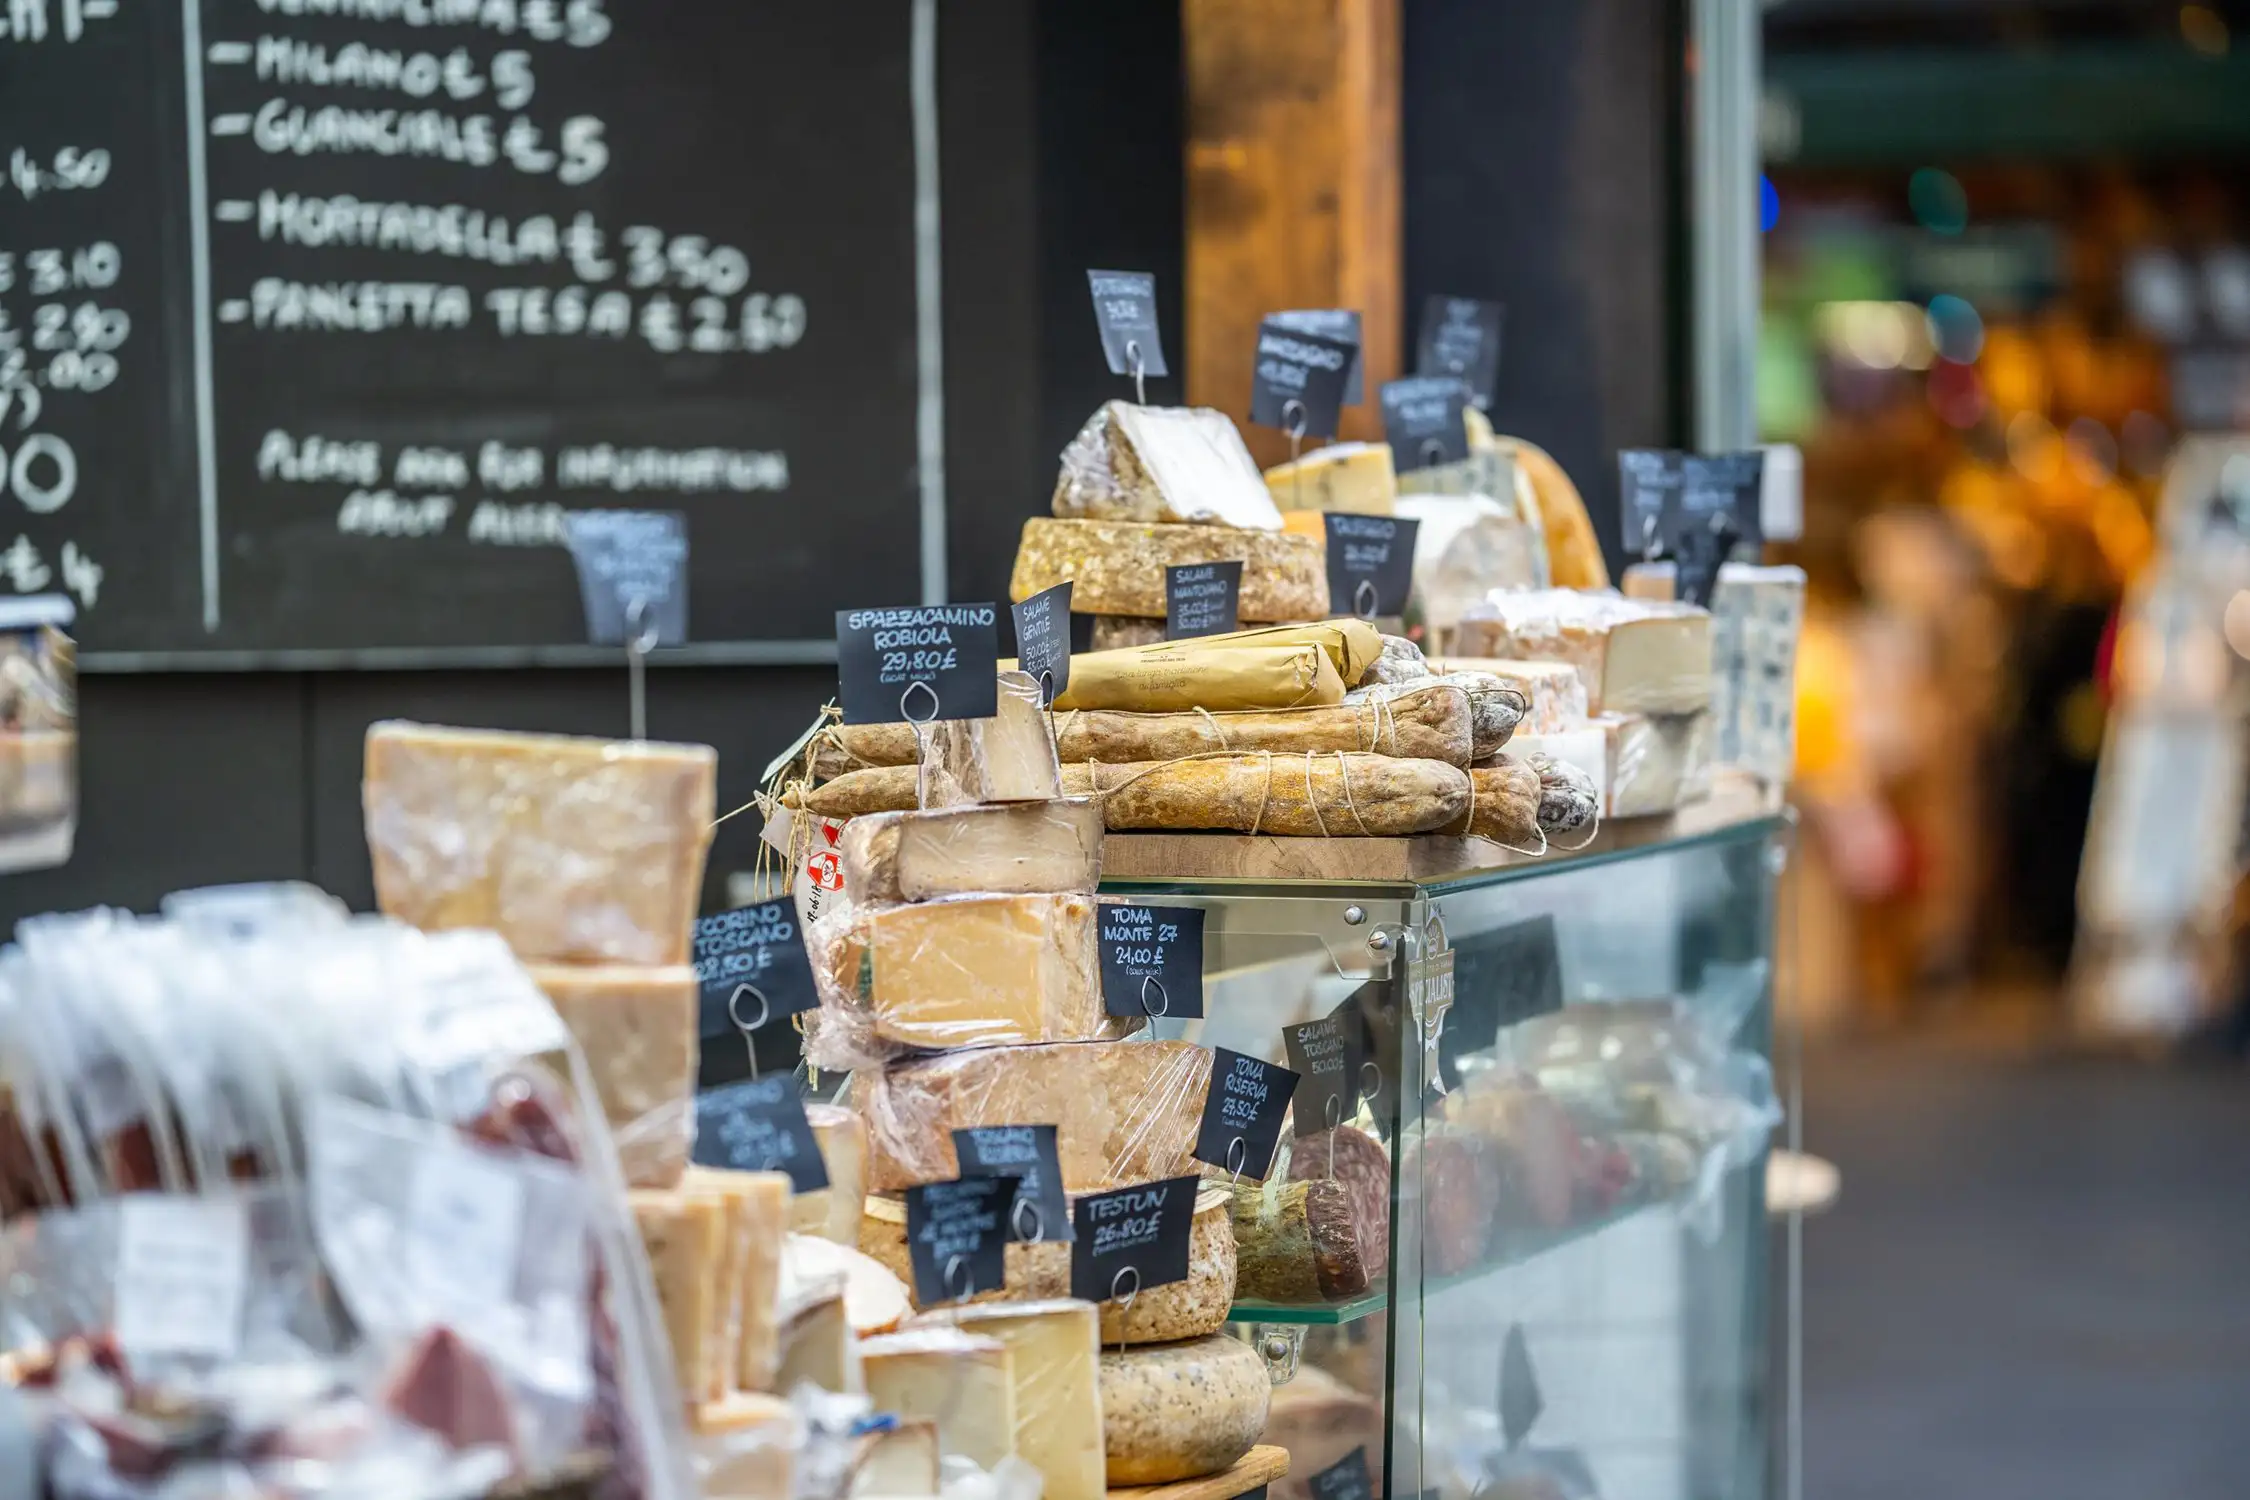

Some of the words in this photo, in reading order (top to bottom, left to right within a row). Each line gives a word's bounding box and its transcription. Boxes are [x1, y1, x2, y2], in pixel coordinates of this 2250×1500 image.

[874, 626, 952, 651] ROBIOLA
[1111, 908, 1153, 923] TOMA
[696, 922, 793, 956] TOSCANO
[1104, 926, 1153, 942] MONTE
[1158, 924, 1178, 942] 27
[1297, 1019, 1337, 1043] SALAME
[1303, 1036, 1344, 1058] TOSCANO
[1236, 1058, 1264, 1081] TOMA
[1224, 1073, 1268, 1102] RISERVA
[1088, 1187, 1168, 1222] TESTUN
